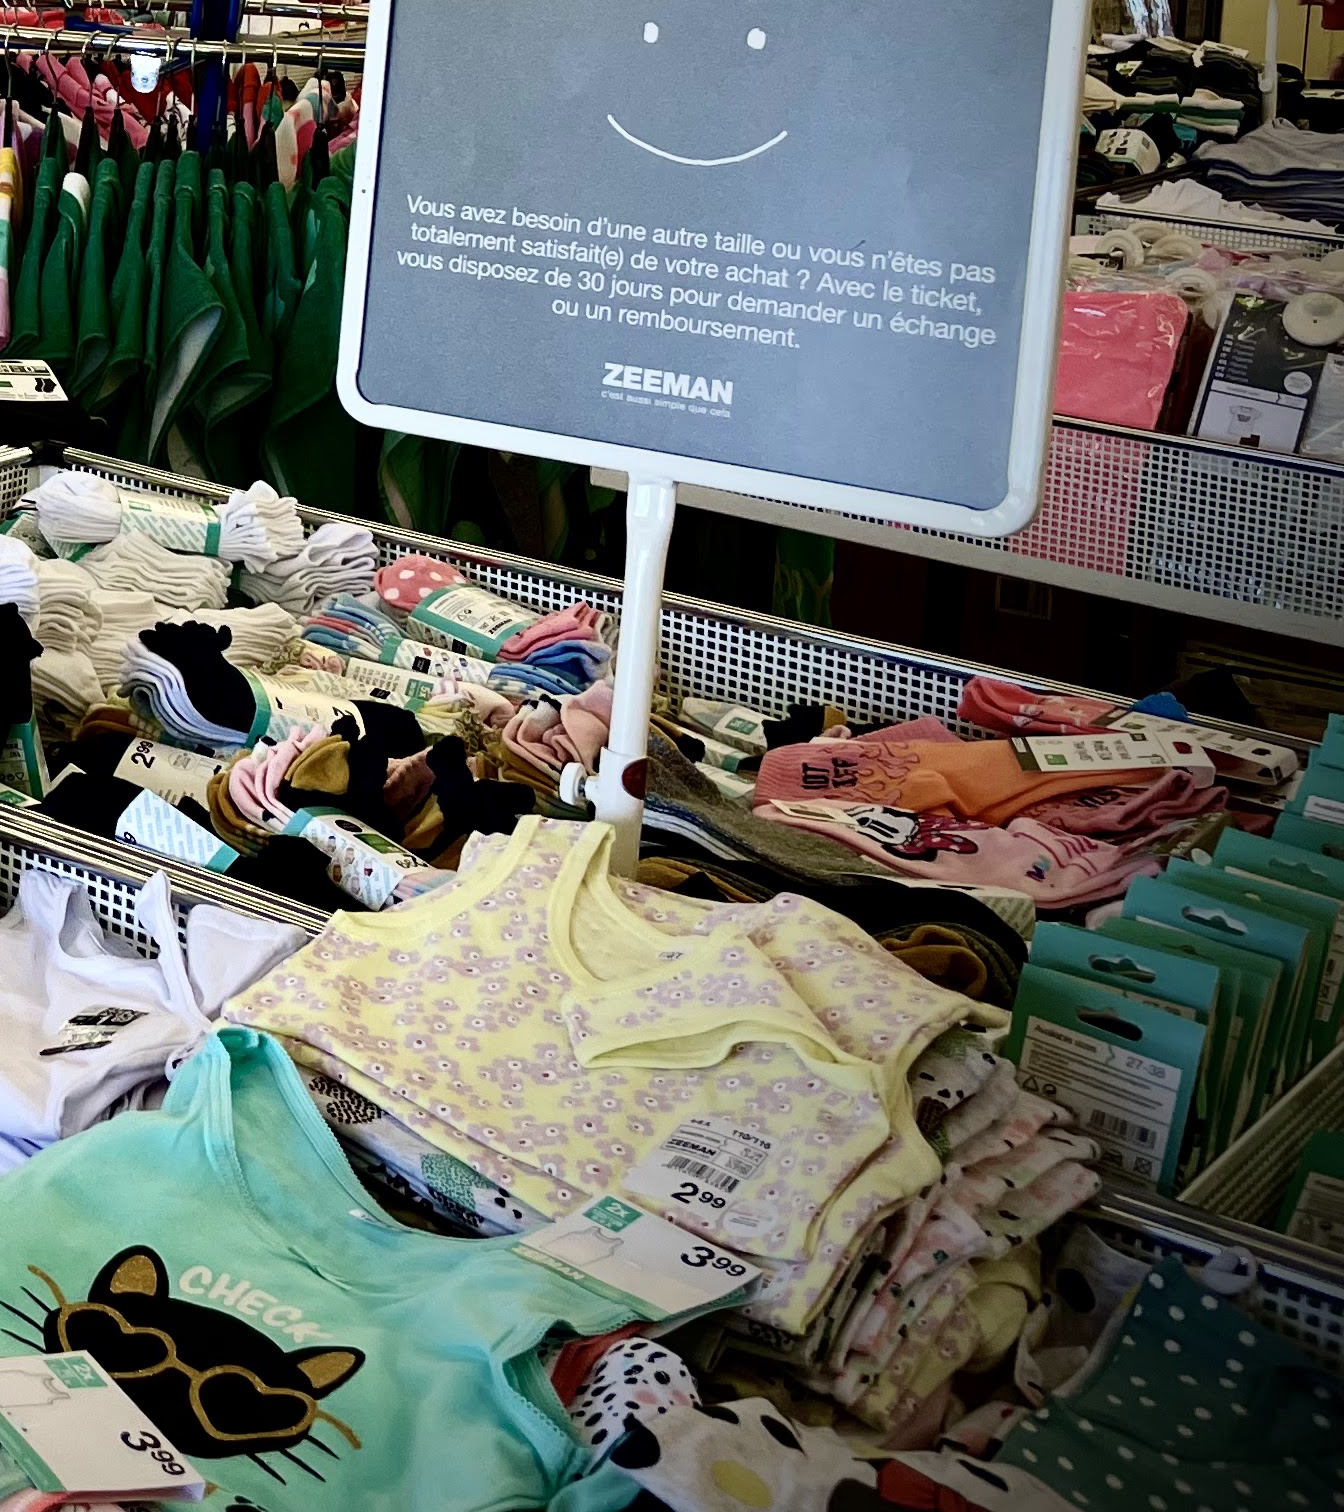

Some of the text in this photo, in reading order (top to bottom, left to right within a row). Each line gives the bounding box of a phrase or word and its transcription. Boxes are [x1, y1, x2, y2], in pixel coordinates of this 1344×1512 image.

[407, 194, 996, 285] Vous avez besoin d'une autre taille ou vous n'êtes pas
[411, 222, 982, 317] totalement satisfait(e) de votre achat ? Avec le ticket,
[397, 250, 996, 348] vous disposez de 30 jours pour demander un échange
[552, 298, 800, 348] ou un remboursement.
[602, 362, 733, 405] ZEEMAN
[688, 405, 706, 415] que
[709, 408, 730, 418] cela
[667, 1138, 716, 1156] ZEEMAN
[671, 1182, 726, 1209] 299
[681, 1246, 746, 1277] 399
[179, 1265, 332, 1344] CHECK
[121, 1430, 186, 1477] 399
